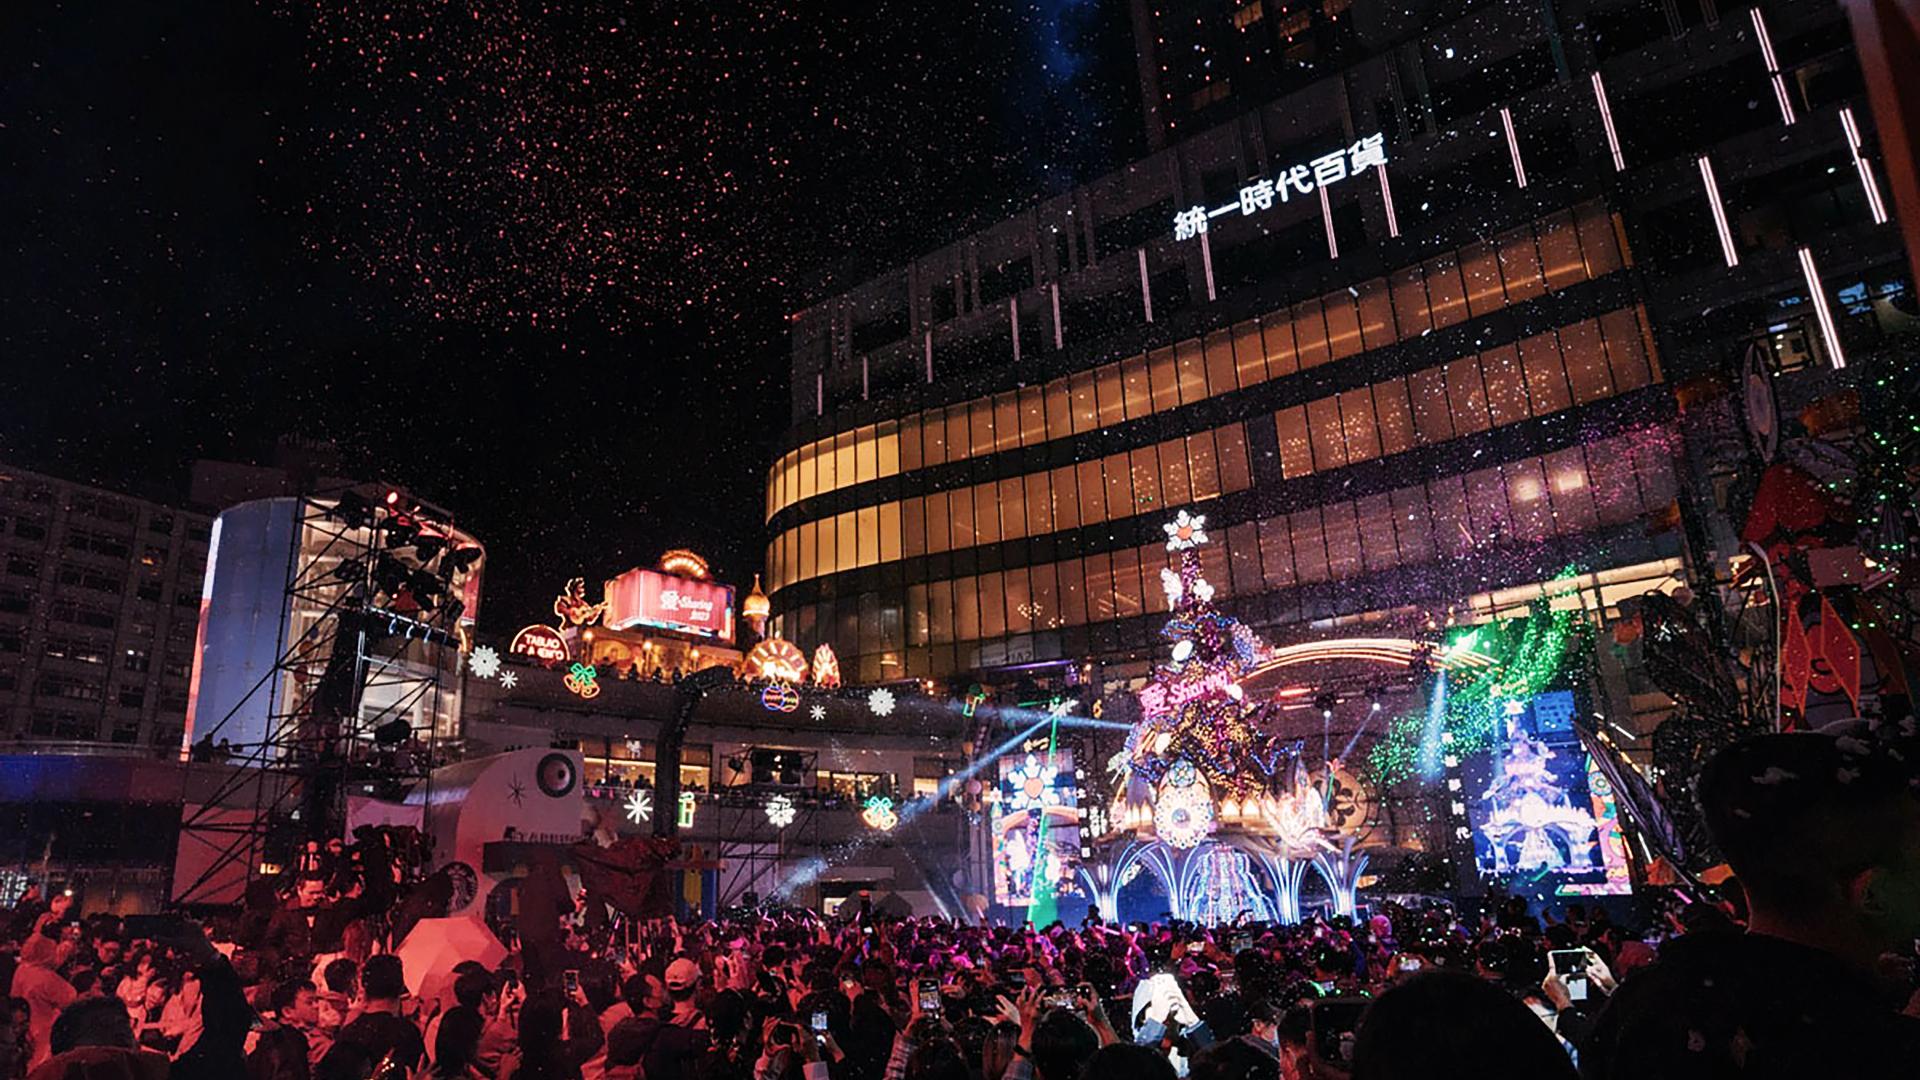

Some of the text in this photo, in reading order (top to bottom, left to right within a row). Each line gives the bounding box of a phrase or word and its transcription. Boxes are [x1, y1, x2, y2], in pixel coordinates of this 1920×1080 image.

[1174, 132, 1388, 241] 統一時代百貨
[1168, 670, 1229, 704] Sharing
